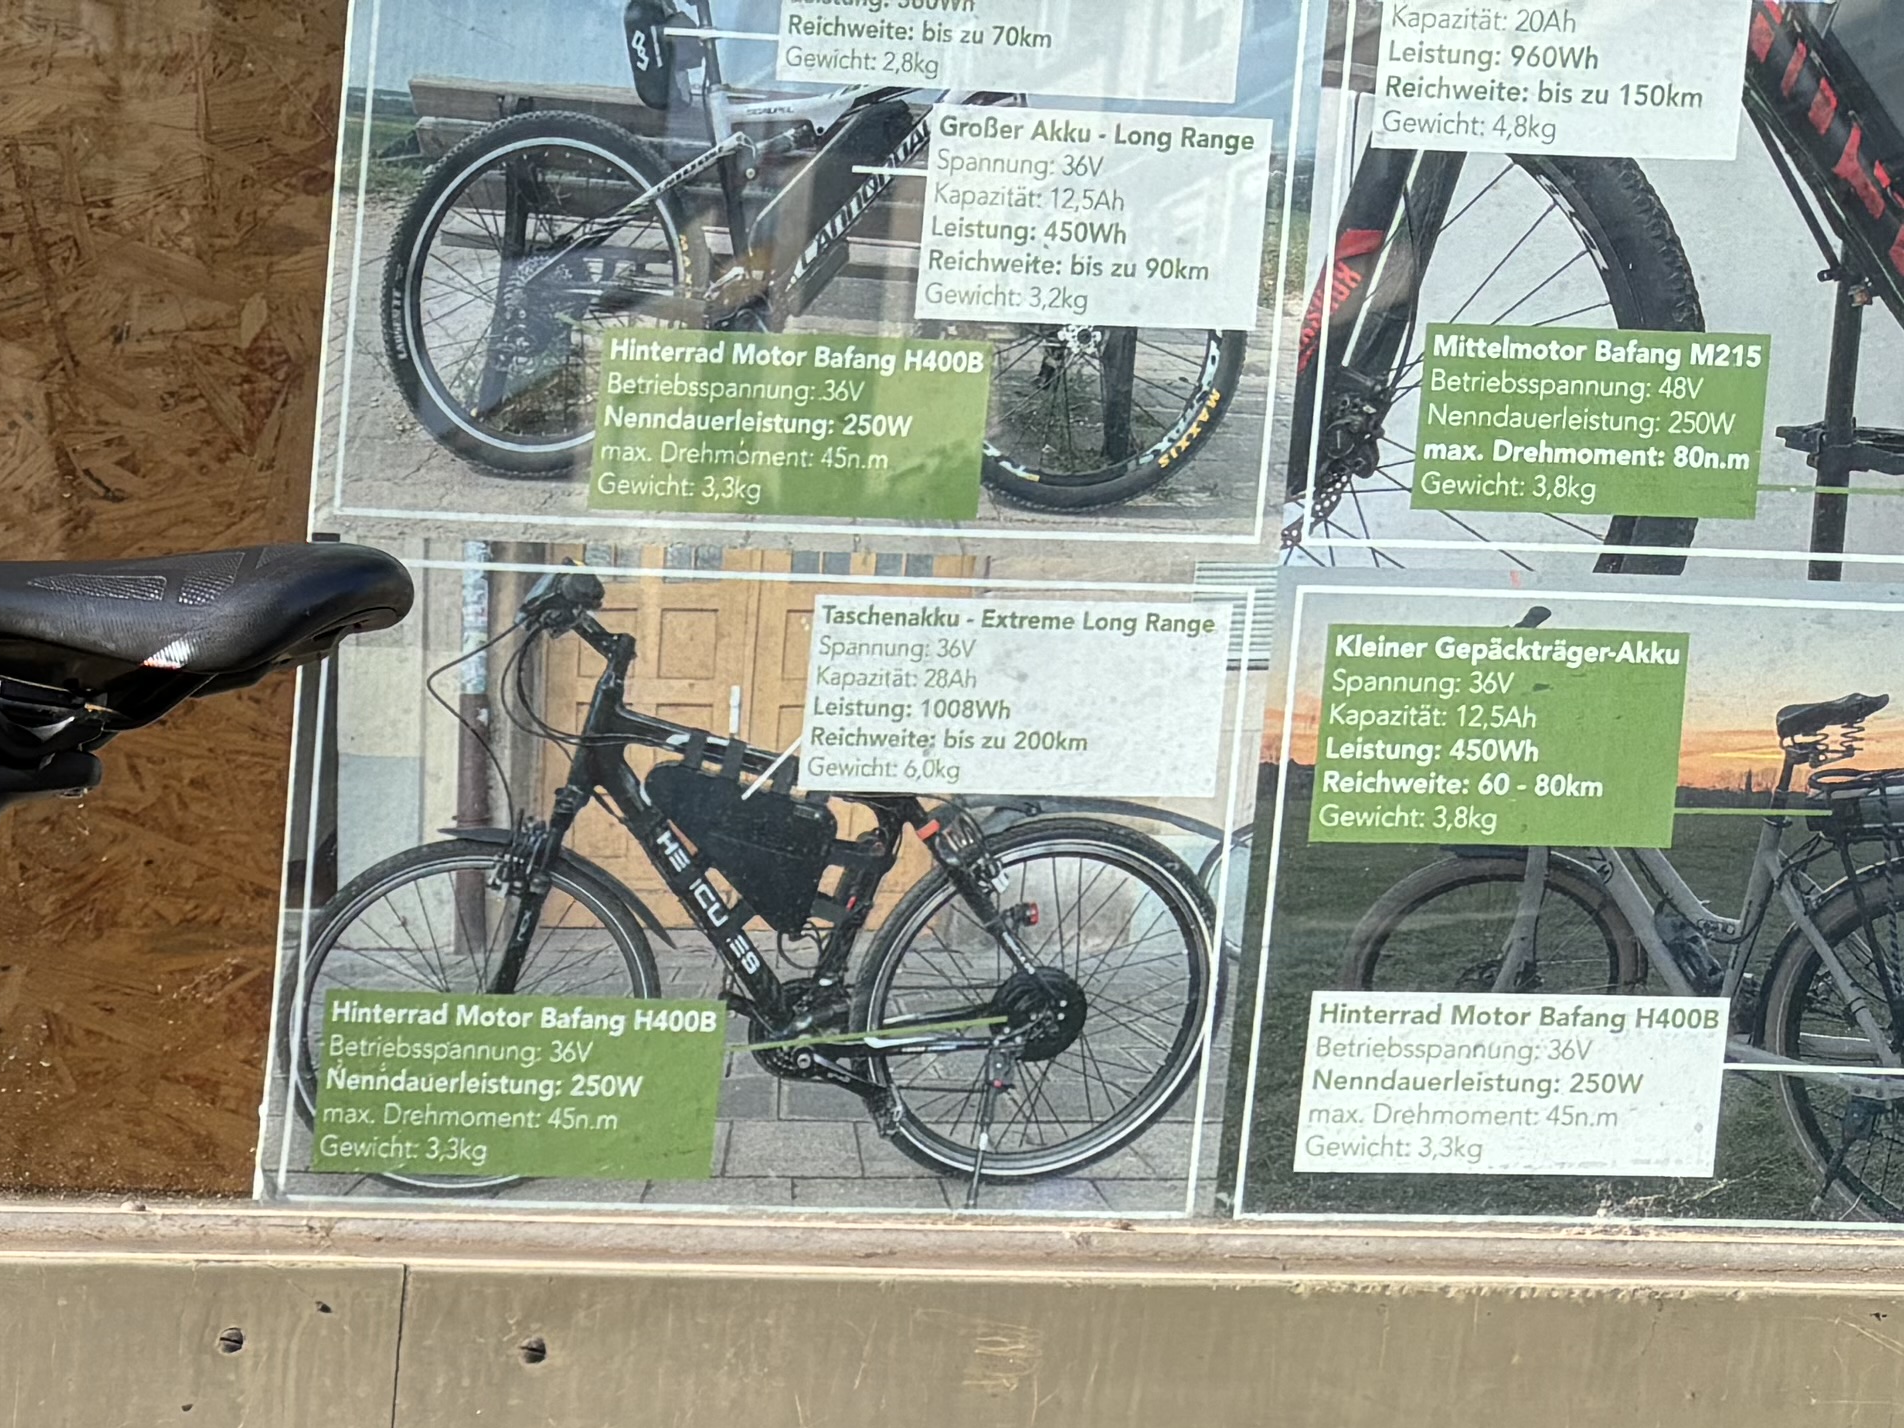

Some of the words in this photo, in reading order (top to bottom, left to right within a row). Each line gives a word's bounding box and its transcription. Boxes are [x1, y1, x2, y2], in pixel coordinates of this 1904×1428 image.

[788, 13, 914, 41] Reichweite:
[921, 19, 953, 43] bis
[959, 30, 984, 45] zu
[992, 25, 1052, 49] 70km
[1391, 3, 1508, 34] Kapazität:
[1514, 8, 1576, 34] 20Ah
[785, 45, 877, 71] Gewicht:
[882, 50, 940, 80] 2,8kg
[1388, 39, 1501, 73] Leistung:
[1510, 44, 1599, 70] 960Wh
[1385, 75, 1529, 103] Reichweite:
[1537, 79, 1573, 104] bis
[1580, 88, 1609, 105] zu
[1619, 82, 1703, 109] 150km
[939, 114, 1025, 140] Großer
[1030, 119, 1091, 144] Akku
[1114, 122, 1172, 153] Long
[1180, 126, 1255, 156] Range
[1381, 109, 1485, 137] Gewicht:
[1492, 113, 1556, 145] 4,8kg
[936, 147, 1055, 181] Spannung:
[1061, 153, 1105, 178] 36V
[934, 181, 1043, 211] Kapazität:
[1050, 186, 1125, 213] 12,5Ah
[931, 215, 1037, 247] Leistung:
[1043, 220, 1127, 250] 450Wh
[928, 248, 1062, 276] Reichweite:
[1070, 253, 1104, 277] bis
[1110, 262, 1137, 278] zu
[1145, 257, 1209, 281] 90km
[924, 281, 1022, 307] Gewicht:
[1029, 285, 1089, 316] 3,2kg
[610, 337, 726, 364] Hinterrad
[731, 342, 808, 367] Motor
[814, 344, 897, 377] Bafang
[903, 348, 984, 374] H400B
[1433, 334, 1588, 362] Mittelmotor
[1594, 338, 1682, 372] Bafang
[1689, 342, 1762, 368] M215
[607, 371, 816, 407] Betriebsspannung:
[818, 378, 866, 402] 36V
[1430, 367, 1653, 405] Betriebsspannung:
[1658, 376, 1705, 401] 48V
[603, 404, 835, 441] Nenndauerleistung:
[841, 412, 913, 438] 250W
[1427, 402, 1661, 439] Nenndauerleistung:
[1667, 410, 1737, 436] 250W
[600, 444, 653, 462] max.
[660, 440, 814, 468] Drehmoment:
[820, 445, 889, 470] 45n.m
[1423, 443, 1484, 461] max.
[1492, 438, 1666, 467] Drehmoment:
[1672, 444, 1750, 471] 80n.m
[597, 471, 695, 497] Gewicht:
[701, 475, 762, 506] 3,3kg
[1420, 470, 1525, 497] Gewicht:
[1532, 474, 1597, 506] 3,8kg
[821, 603, 960, 628] Taschenakku
[980, 608, 1076, 630] Extreme
[1082, 610, 1138, 637] Long
[1145, 612, 1216, 639] Range
[818, 634, 930, 664] Spannung:
[936, 637, 977, 659] 36V
[1335, 633, 1427, 661] Kleiner
[1434, 635, 1682, 669] Gepäckträger-Akku
[816, 665, 919, 692] Kapazität:
[923, 667, 977, 689] 28Ah
[1332, 667, 1462, 700] Spannung:
[1468, 670, 1515, 695] 36V
[813, 695, 912, 724] Leistung:
[921, 698, 1011, 720] 1008Wh
[1329, 702, 1448, 732] Kapazität:
[1456, 704, 1537, 731] 12,5Ah
[810, 725, 937, 757] Reichweite:
[943, 727, 975, 750] bis
[981, 735, 1006, 750] zu
[1013, 730, 1088, 752] 200km
[1325, 735, 1442, 767] Leistung:
[1448, 738, 1539, 762] 450Wh
[807, 755, 899, 778] Gewicht:
[903, 758, 961, 785] 6,0kg
[1322, 771, 1470, 798] Reichweite:
[1477, 772, 1510, 796] 60
[1534, 772, 1604, 798] 80km
[1318, 804, 1426, 831] Gewicht:
[1432, 804, 1498, 836] 3,8kg
[331, 999, 449, 1026] Hinterrad
[455, 1003, 534, 1028] Motor
[540, 1005, 626, 1037] Bafang
[633, 1008, 717, 1033] H400B
[1319, 1002, 1443, 1025] Hinterrad
[1450, 1004, 1532, 1027] Motor
[1539, 1004, 1627, 1034] Bafang
[1635, 1007, 1722, 1031] H400B
[328, 1033, 542, 1066] Betriebsspannung:
[549, 1039, 594, 1063] 36V
[1316, 1035, 1541, 1067] Betriebsspannung:
[1547, 1038, 1594, 1061] 36V
[325, 1065, 563, 1102] Nenndauerleistung:
[569, 1073, 644, 1098] 250W
[1312, 1068, 1561, 1100] Nenndauerleistung:
[1569, 1072, 1644, 1095] 250W
[322, 1107, 376, 1125] max.
[383, 1102, 542, 1129] Drehmoment:
[547, 1106, 618, 1131] 45n.m
[1308, 1108, 1364, 1124] max.
[1372, 1101, 1540, 1127] Drehmoment:
[1545, 1104, 1618, 1128] 45n.m
[319, 1133, 420, 1159] Gewicht:
[425, 1136, 488, 1167] 3,3kg
[1305, 1133, 1411, 1158] Gewicht:
[1417, 1135, 1484, 1165] 3,3kg
